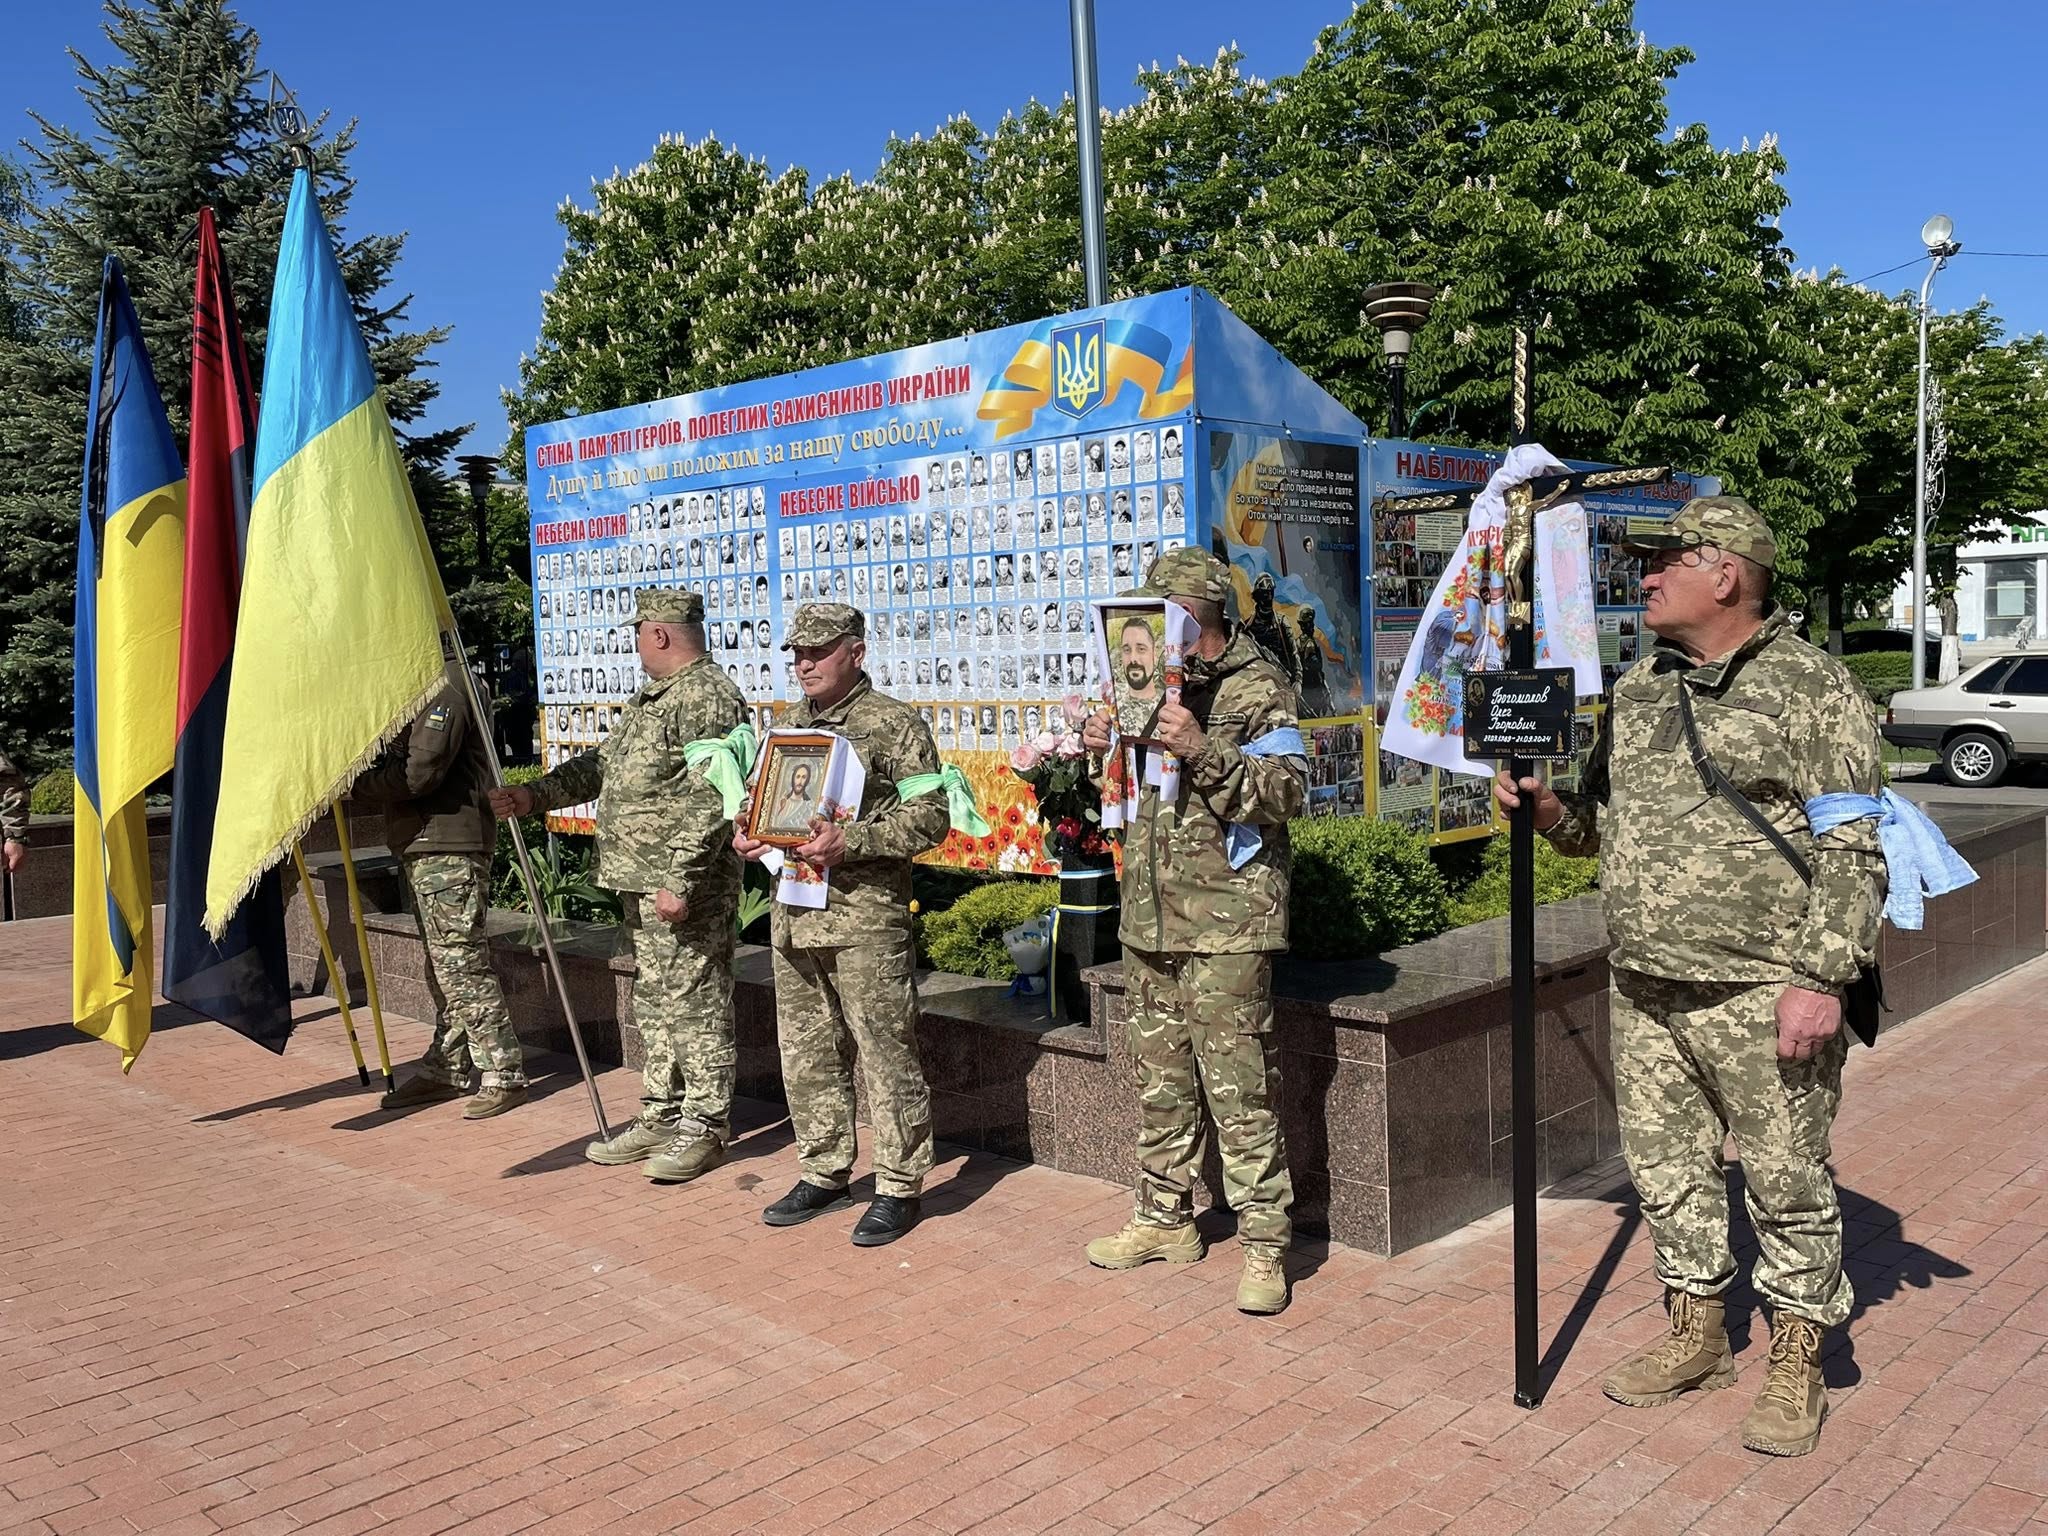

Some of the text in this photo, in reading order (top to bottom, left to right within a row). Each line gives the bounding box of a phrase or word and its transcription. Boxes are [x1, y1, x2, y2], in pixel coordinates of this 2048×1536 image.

[537, 363, 971, 468] СТІНА ПАМ'ЯТІ ГЕРОЇВ, ПОЛЕГЛИХ ЗАХИСНИКІВ УКРАЇНИ
[546, 416, 964, 504] Душу й тіло ми положим за нашу свободу...
[1256, 463, 1267, 475] Ми
[1290, 467, 1299, 477] Не
[1325, 470, 1335, 480] Не
[1335, 471, 1354, 482] лежні
[779, 487, 845, 517] НЕБЕСНЕ
[848, 474, 921, 510] ВІЙСЬКО
[1260, 481, 1278, 491] наше
[1296, 484, 1328, 495] праведне
[1235, 493, 1245, 504] Бо
[1247, 495, 1259, 504] хто
[1260, 496, 1268, 505] за
[1290, 498, 1300, 507] ми
[1301, 498, 1309, 507] за
[1248, 508, 1267, 520] Отож
[1268, 511, 1282, 521] нам
[1284, 512, 1295, 522] так
[1300, 514, 1321, 524] важко
[1322, 514, 1341, 526] через
[535, 518, 586, 546] НЕБЕСНА
[588, 513, 628, 541] СОТНЯ
[1490, 704, 1512, 717] Олег
[1488, 717, 1537, 733] Ігорович
